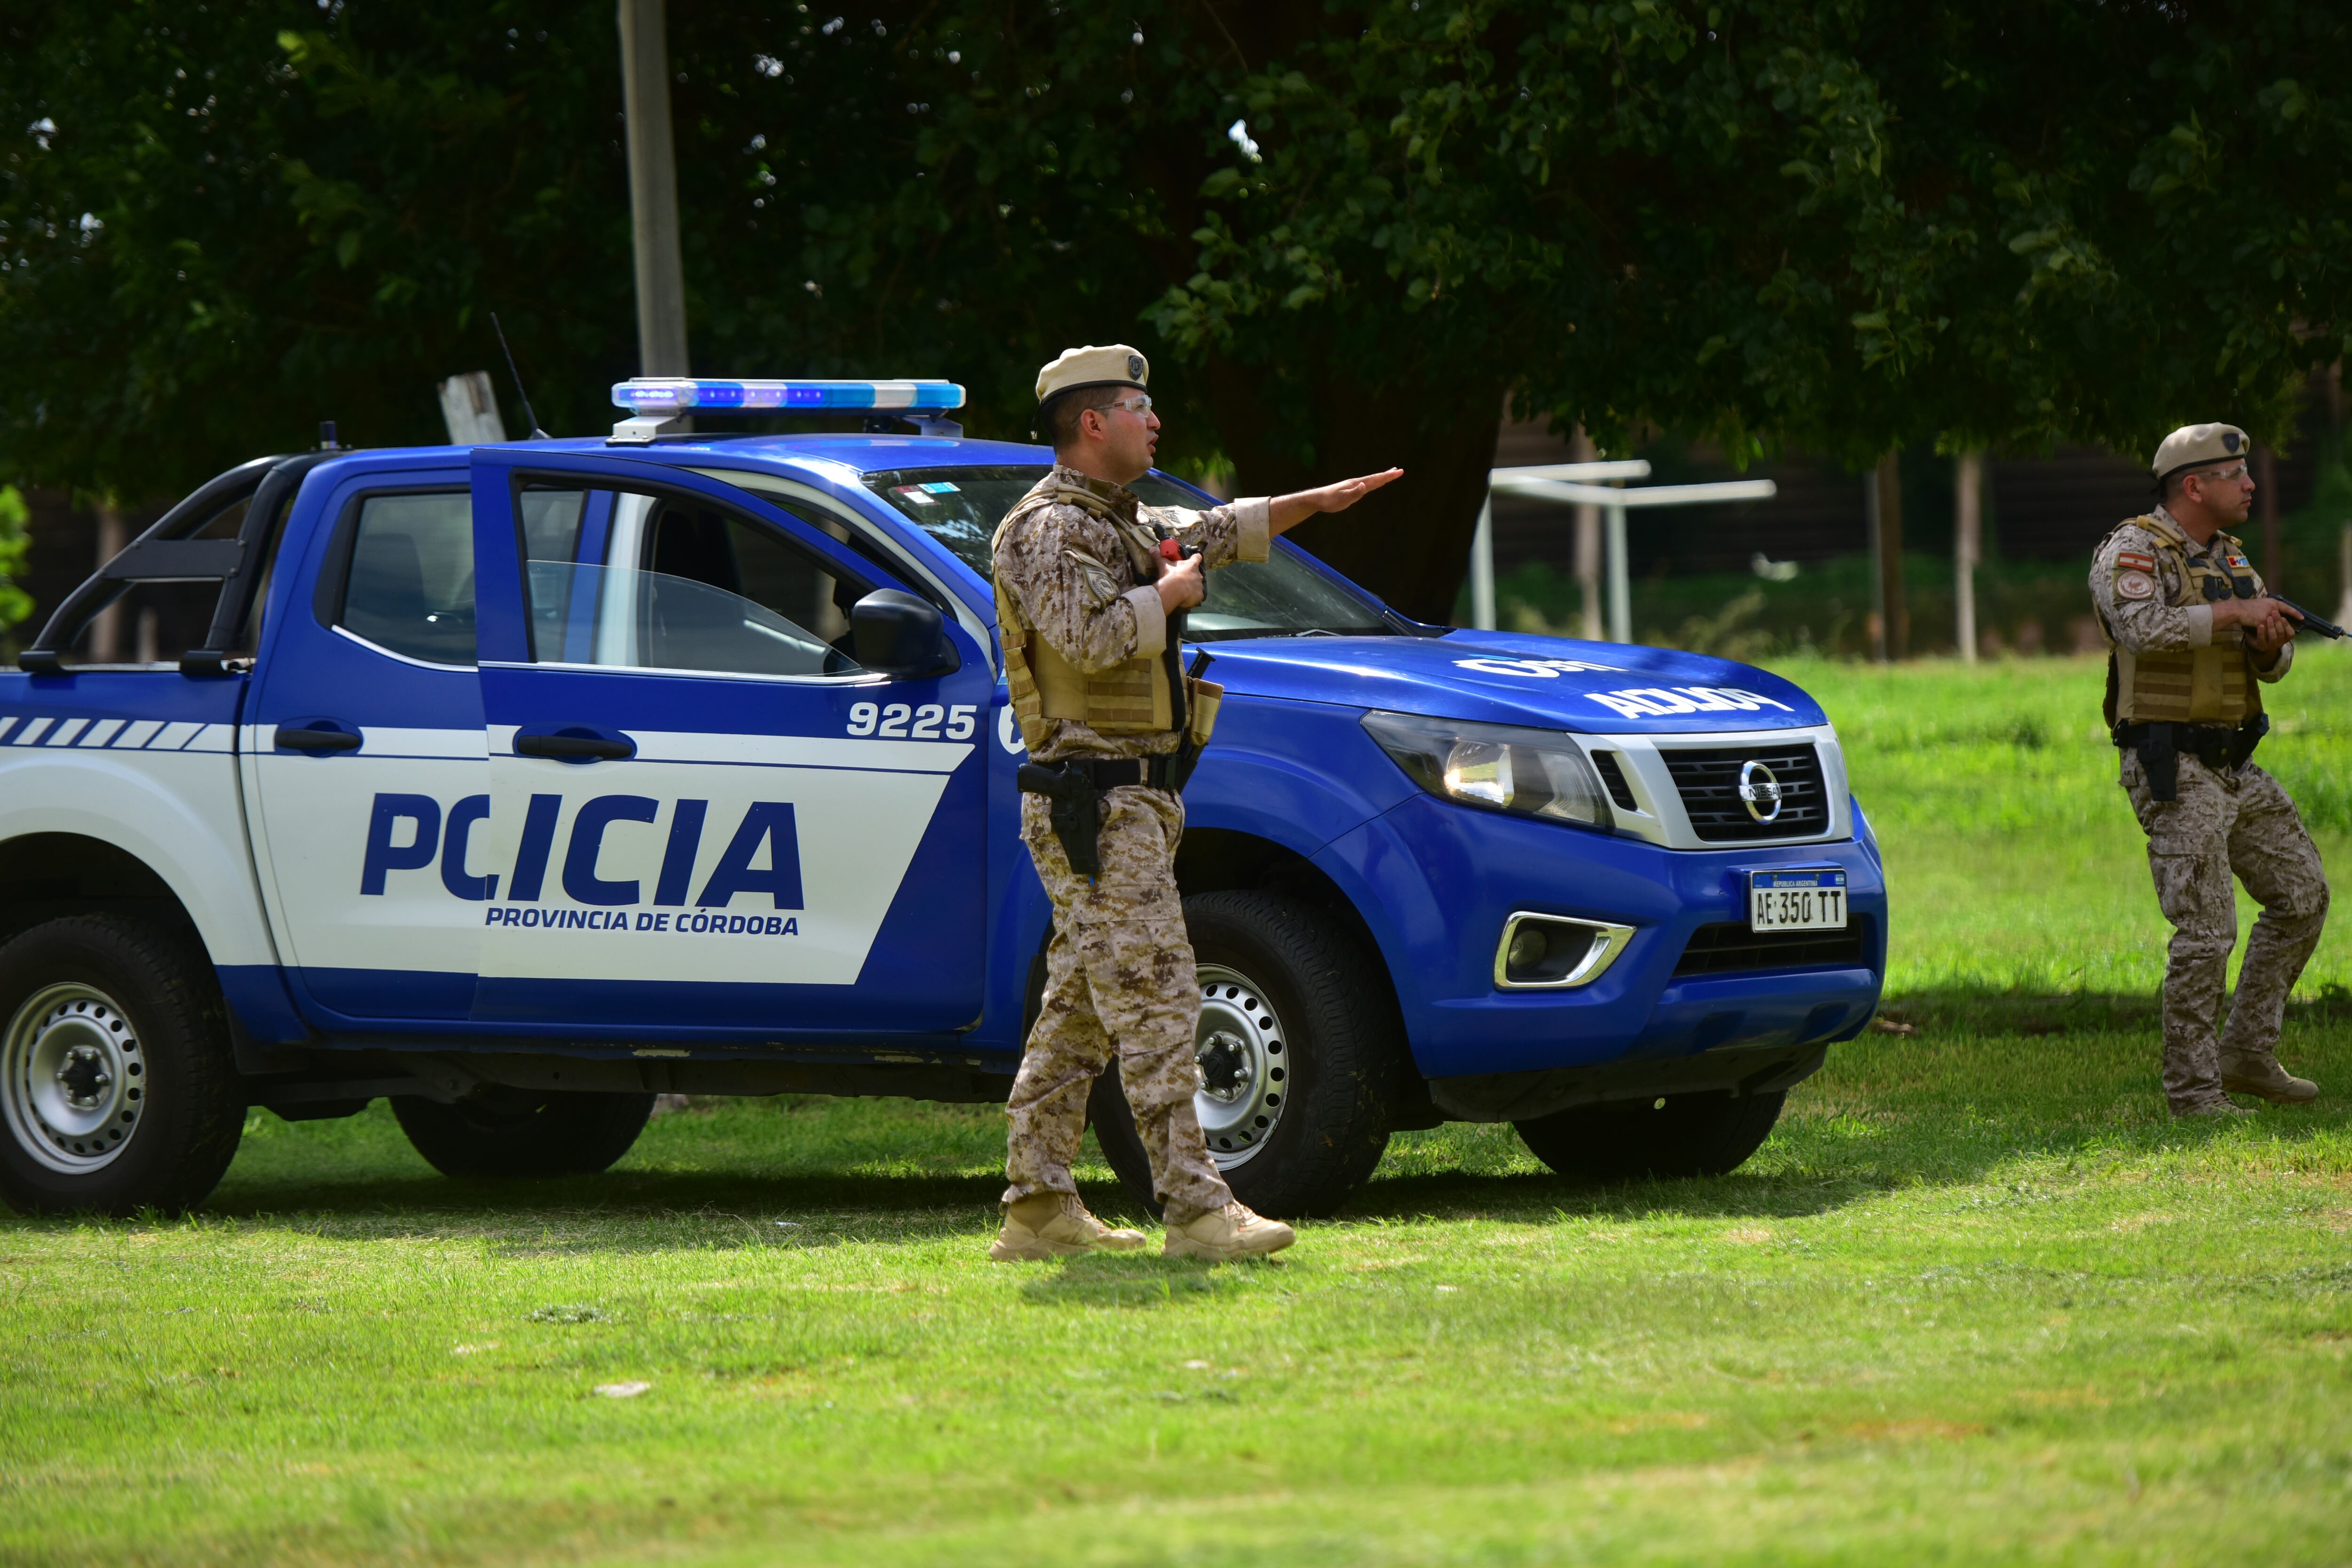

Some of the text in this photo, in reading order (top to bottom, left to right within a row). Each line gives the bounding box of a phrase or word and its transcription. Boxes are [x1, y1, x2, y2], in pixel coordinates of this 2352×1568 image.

[847, 702, 977, 740] 9225
[485, 907, 798, 936] PROVINCIA DE CÓRDOBA
[1757, 891, 1841, 924] AE 350 TT
